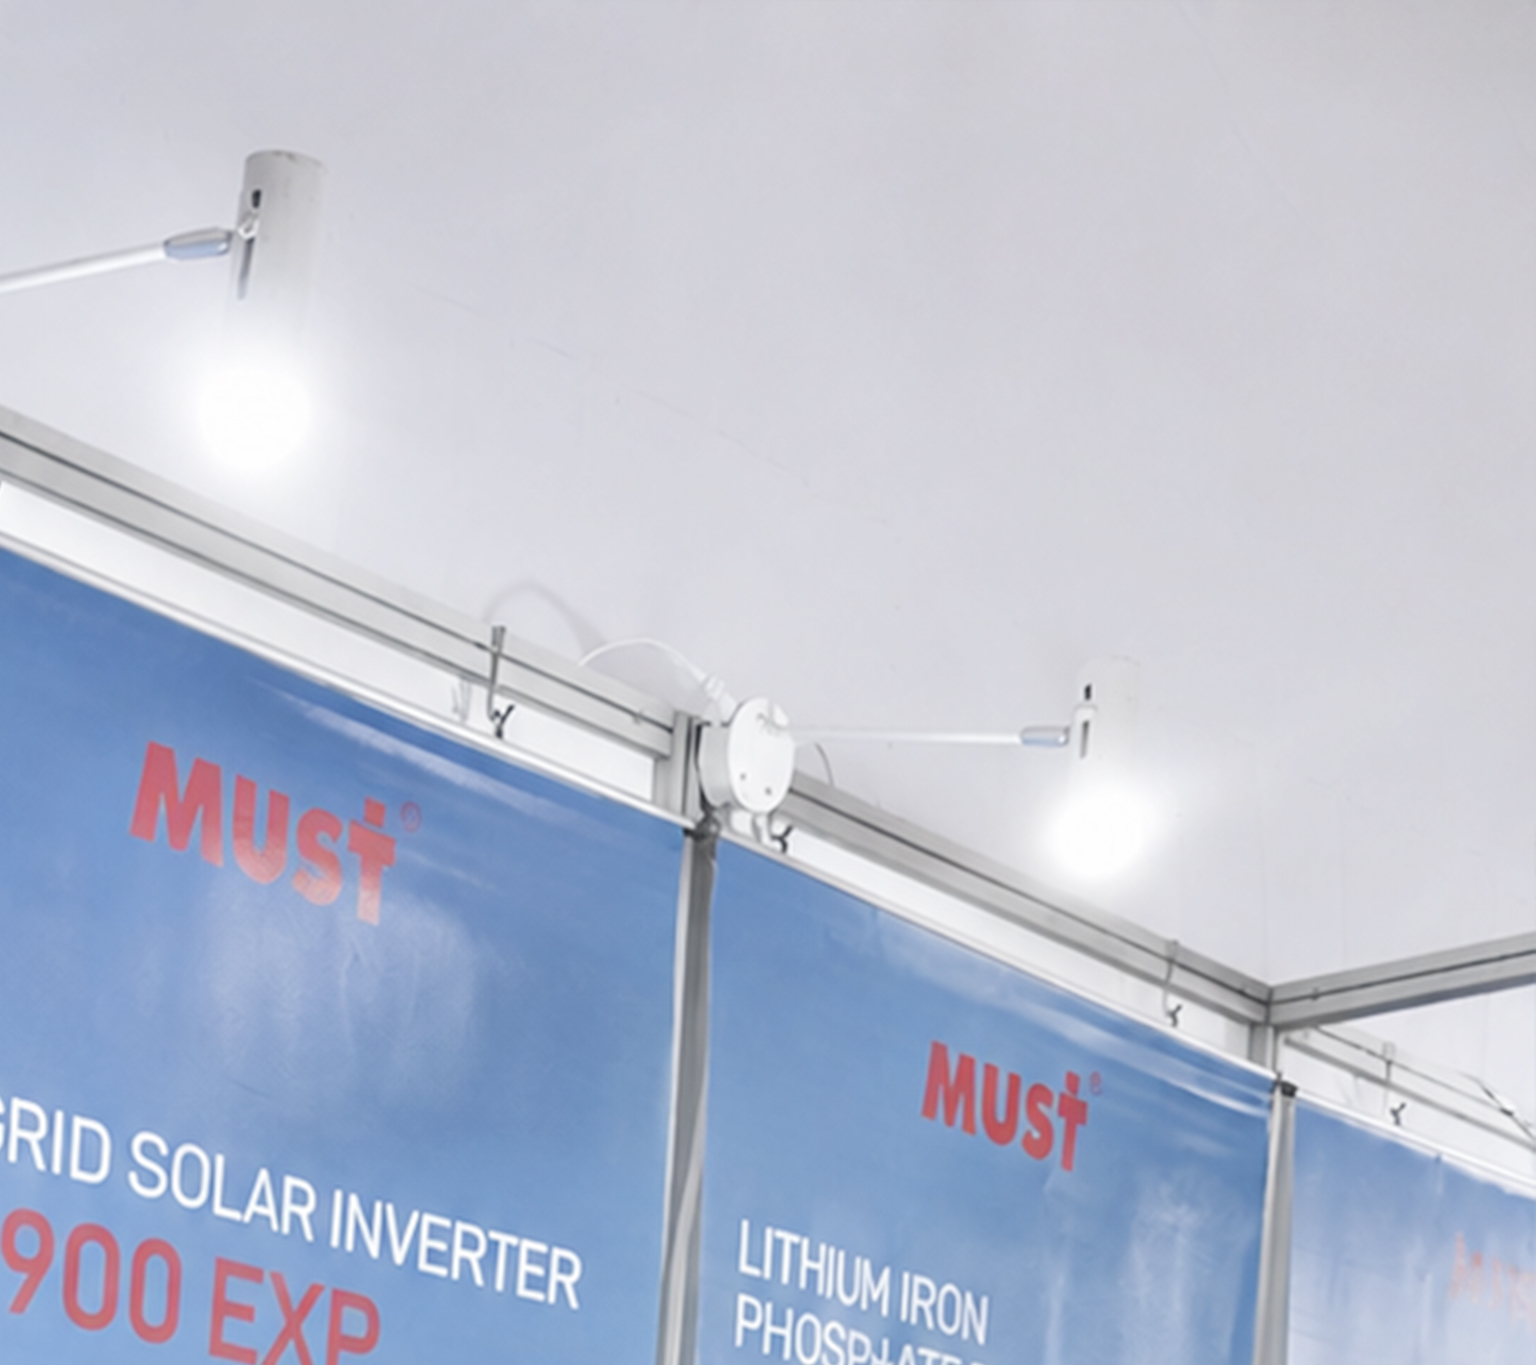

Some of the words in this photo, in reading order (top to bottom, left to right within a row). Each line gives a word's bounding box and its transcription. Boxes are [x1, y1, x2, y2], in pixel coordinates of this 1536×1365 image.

[127, 1131, 317, 1242] SOLAR
[329, 1193, 584, 1309] INVERTER
[738, 1219, 891, 1316] LITHIUM
[900, 1271, 989, 1345] IRON
